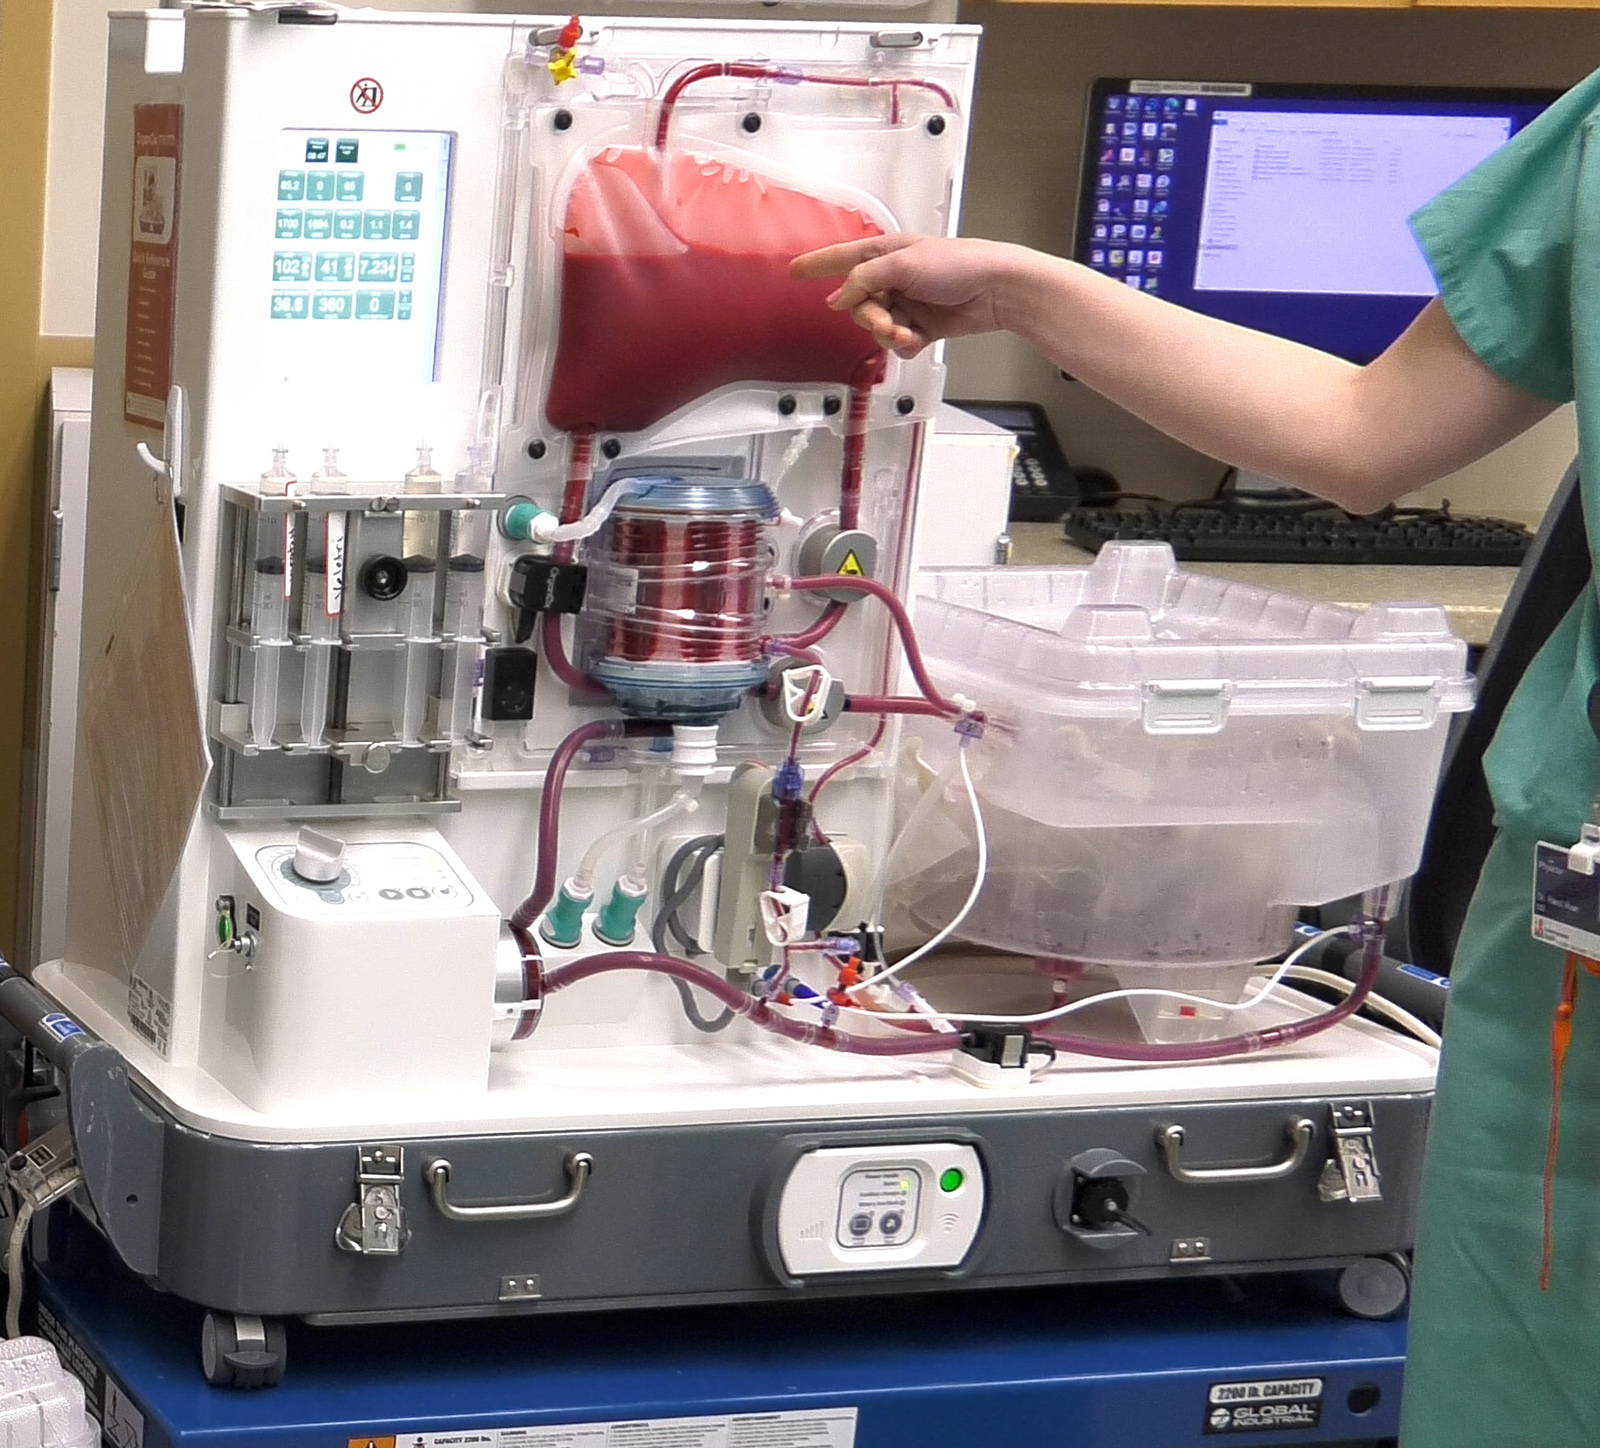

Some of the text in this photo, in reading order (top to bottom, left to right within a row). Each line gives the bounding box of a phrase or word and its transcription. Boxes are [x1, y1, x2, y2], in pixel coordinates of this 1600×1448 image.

[278, 219, 298, 228] 1700
[370, 220, 383, 229] 1.1
[275, 260, 300, 274] 102
[321, 260, 338, 274] 41
[360, 260, 388, 274] 7.23
[273, 297, 303, 311] 36.6
[319, 297, 345, 311] 360
[369, 298, 380, 312] 0
[1217, 1386, 1246, 1400] 2200
[1263, 1382, 1315, 1397] CAPACITY
[1233, 1403, 1315, 1418] GLOBAL
[1232, 1414, 1314, 1426] INDUSTRIAL
